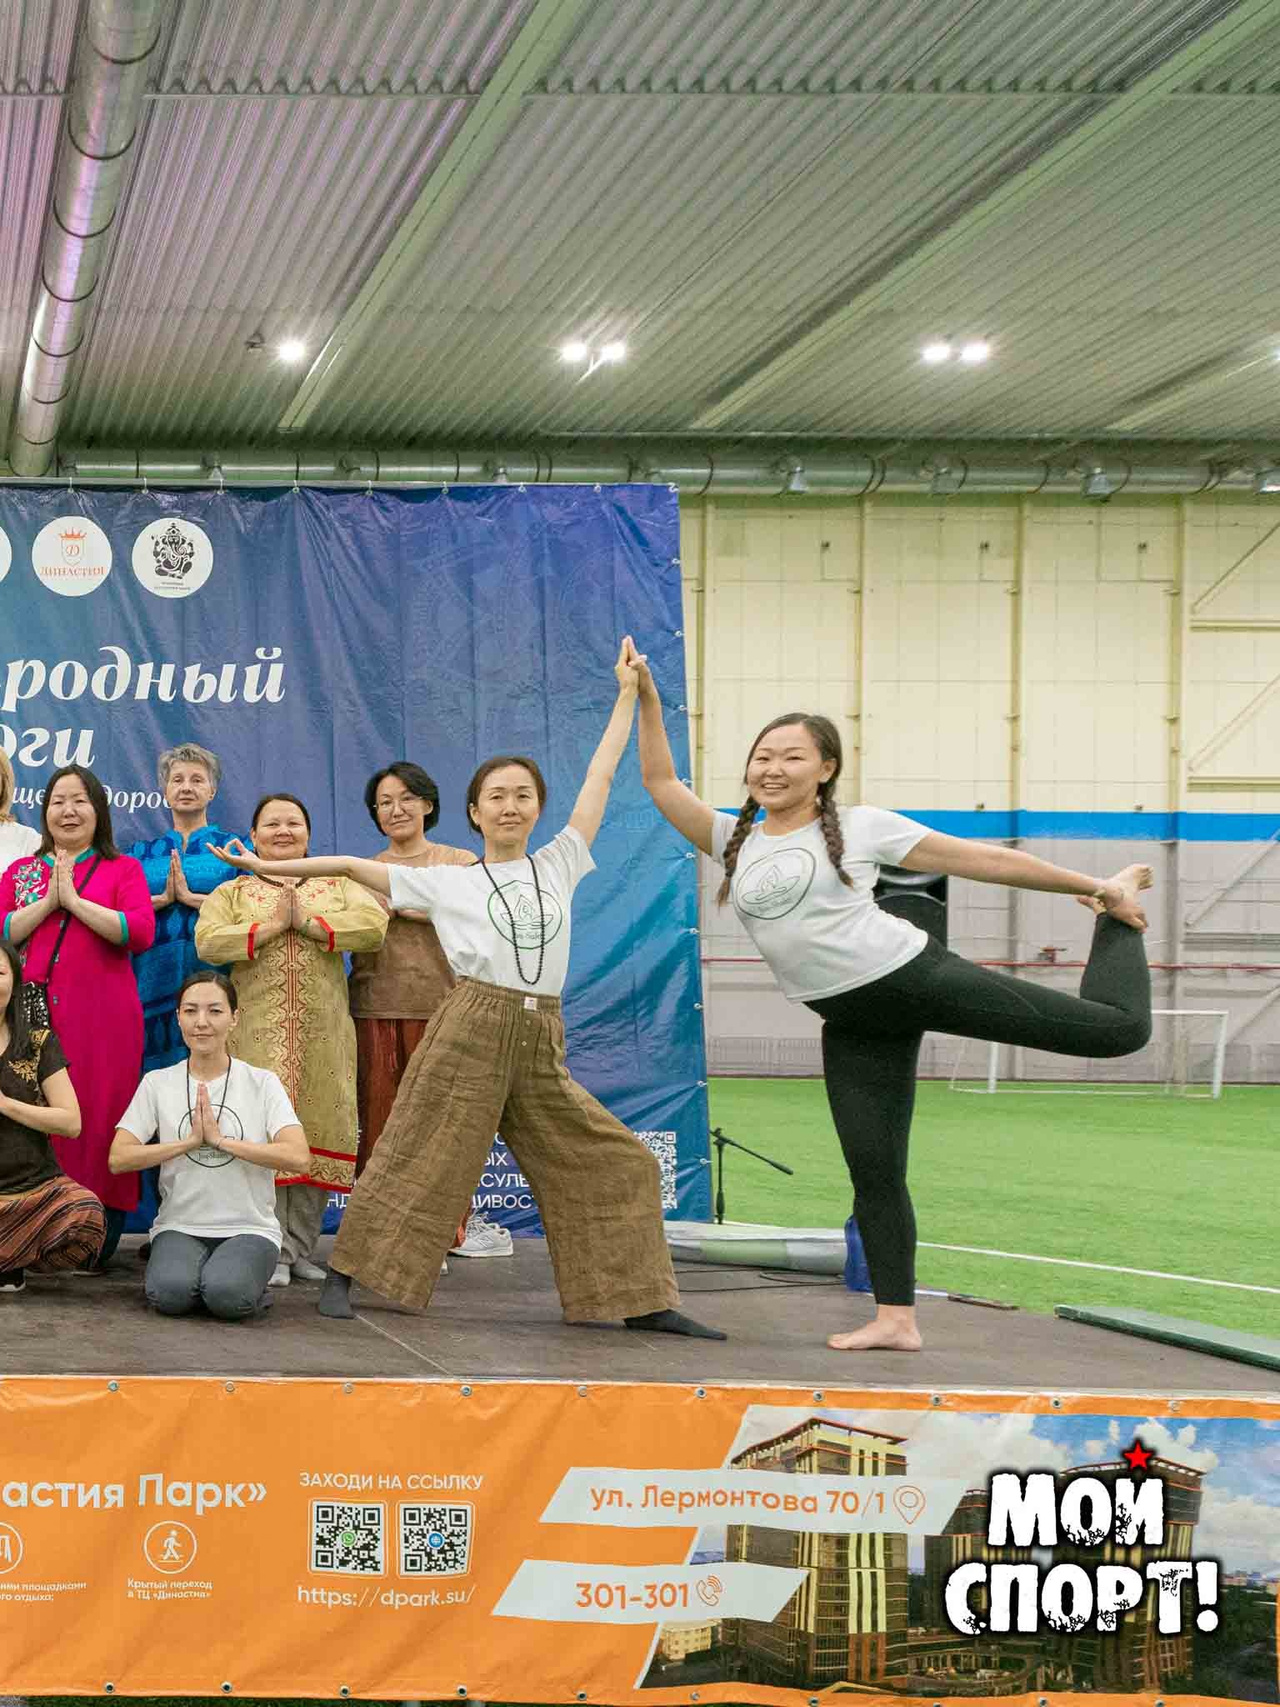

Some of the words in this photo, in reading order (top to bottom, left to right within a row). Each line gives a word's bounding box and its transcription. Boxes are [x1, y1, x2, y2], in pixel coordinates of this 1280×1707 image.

[139, 1473, 268, 1516] Парк»
[300, 1473, 373, 1491] ЗАХОДИ
[378, 1475, 402, 1489] НА
[407, 1475, 484, 1490] ССЫЛКУ
[591, 1487, 632, 1511] ул.
[641, 1485, 818, 1514] Лермонтова
[827, 1489, 886, 1519] 70/1
[297, 1584, 477, 1609] https://dpark.su/
[576, 1582, 688, 1609] 301-301
